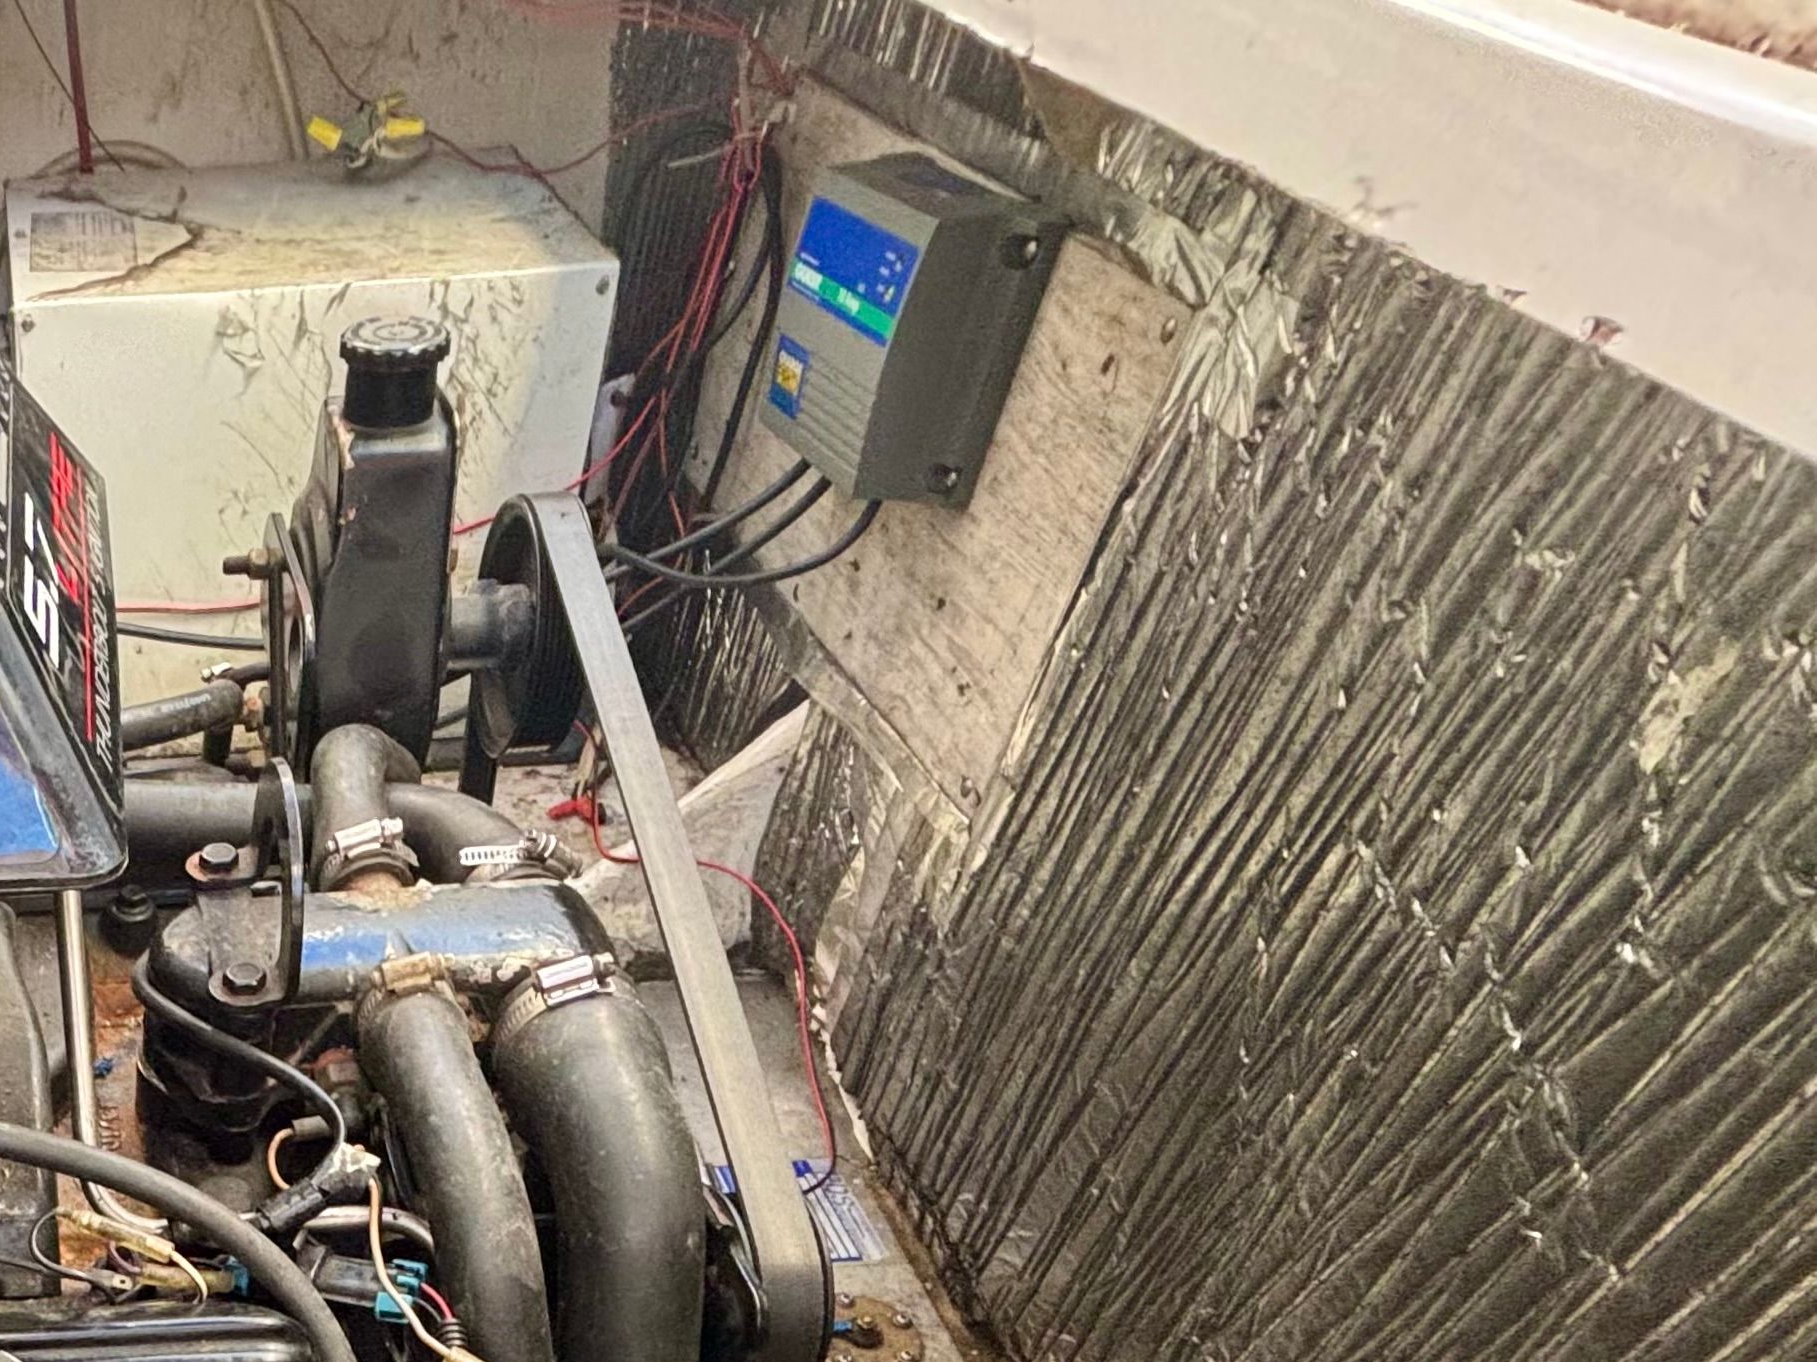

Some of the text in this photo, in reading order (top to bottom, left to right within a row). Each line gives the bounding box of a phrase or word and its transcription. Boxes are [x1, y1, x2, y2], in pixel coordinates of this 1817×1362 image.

[24, 491, 60, 669] 5.7
[50, 431, 82, 606] LITRE
[90, 582, 114, 774] THUNDERBOLT
